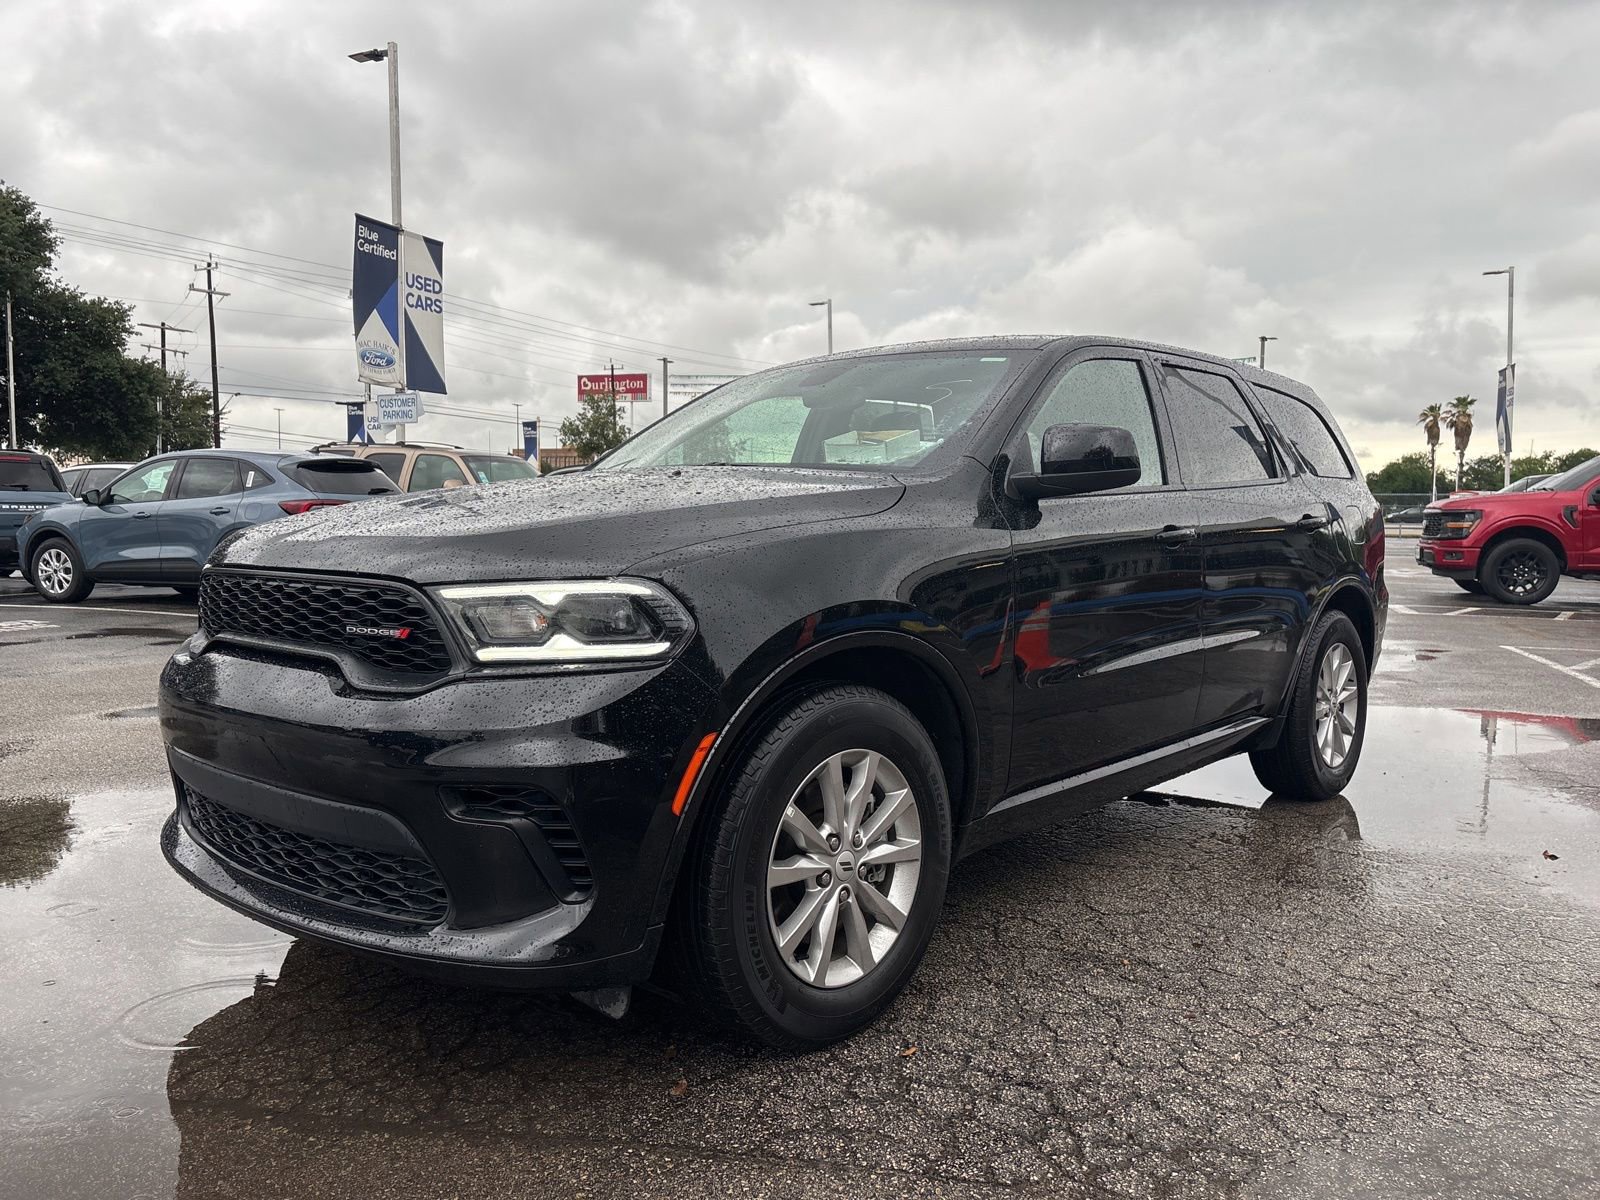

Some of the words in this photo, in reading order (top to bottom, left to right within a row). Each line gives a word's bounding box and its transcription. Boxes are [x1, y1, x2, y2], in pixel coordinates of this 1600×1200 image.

[358, 225, 379, 241] Blue
[357, 239, 397, 260] Certified
[405, 272, 443, 294] USED
[405, 292, 443, 314] CARS
[364, 350, 388, 366] Ford
[581, 377, 644, 393] Burlington
[379, 398, 416, 409] CUSTOMER
[382, 409, 413, 420] PARKING
[346, 626, 401, 636] DODGE
[744, 888, 771, 982] MICHELIN
